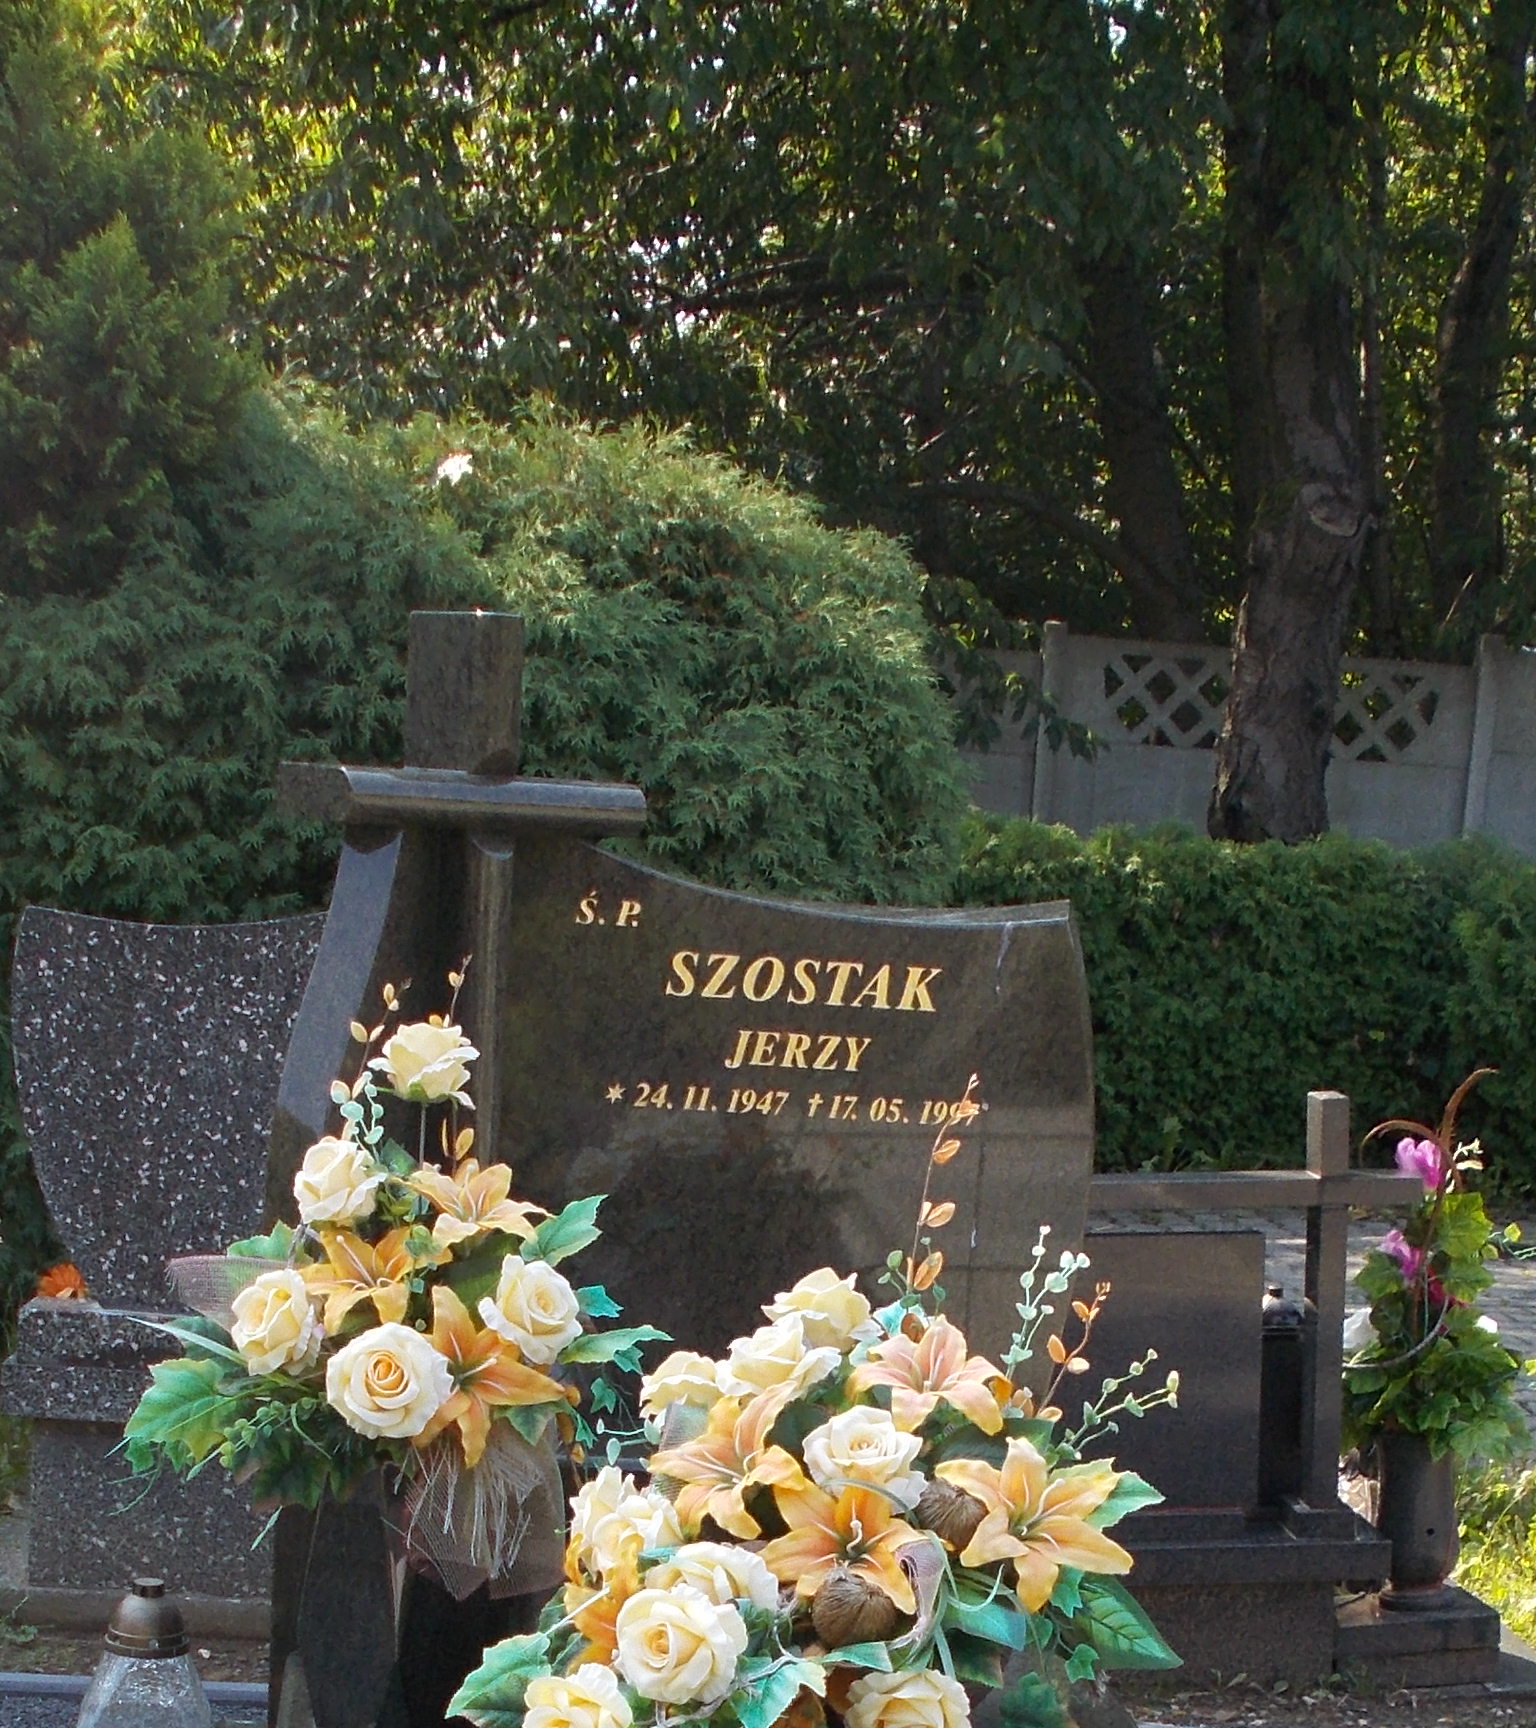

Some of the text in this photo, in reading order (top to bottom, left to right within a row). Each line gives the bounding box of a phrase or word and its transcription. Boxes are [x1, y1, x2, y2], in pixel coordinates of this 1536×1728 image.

[576, 891, 642, 928] Ś. P.
[665, 950, 943, 1013] SZOSTAK
[724, 1030, 872, 1072] JERZY
[633, 1083, 673, 1110] 24.
[684, 1086, 717, 1112] 11.
[726, 1089, 790, 1116] 1947
[829, 1095, 859, 1120] 17.
[869, 1097, 909, 1124] 05.
